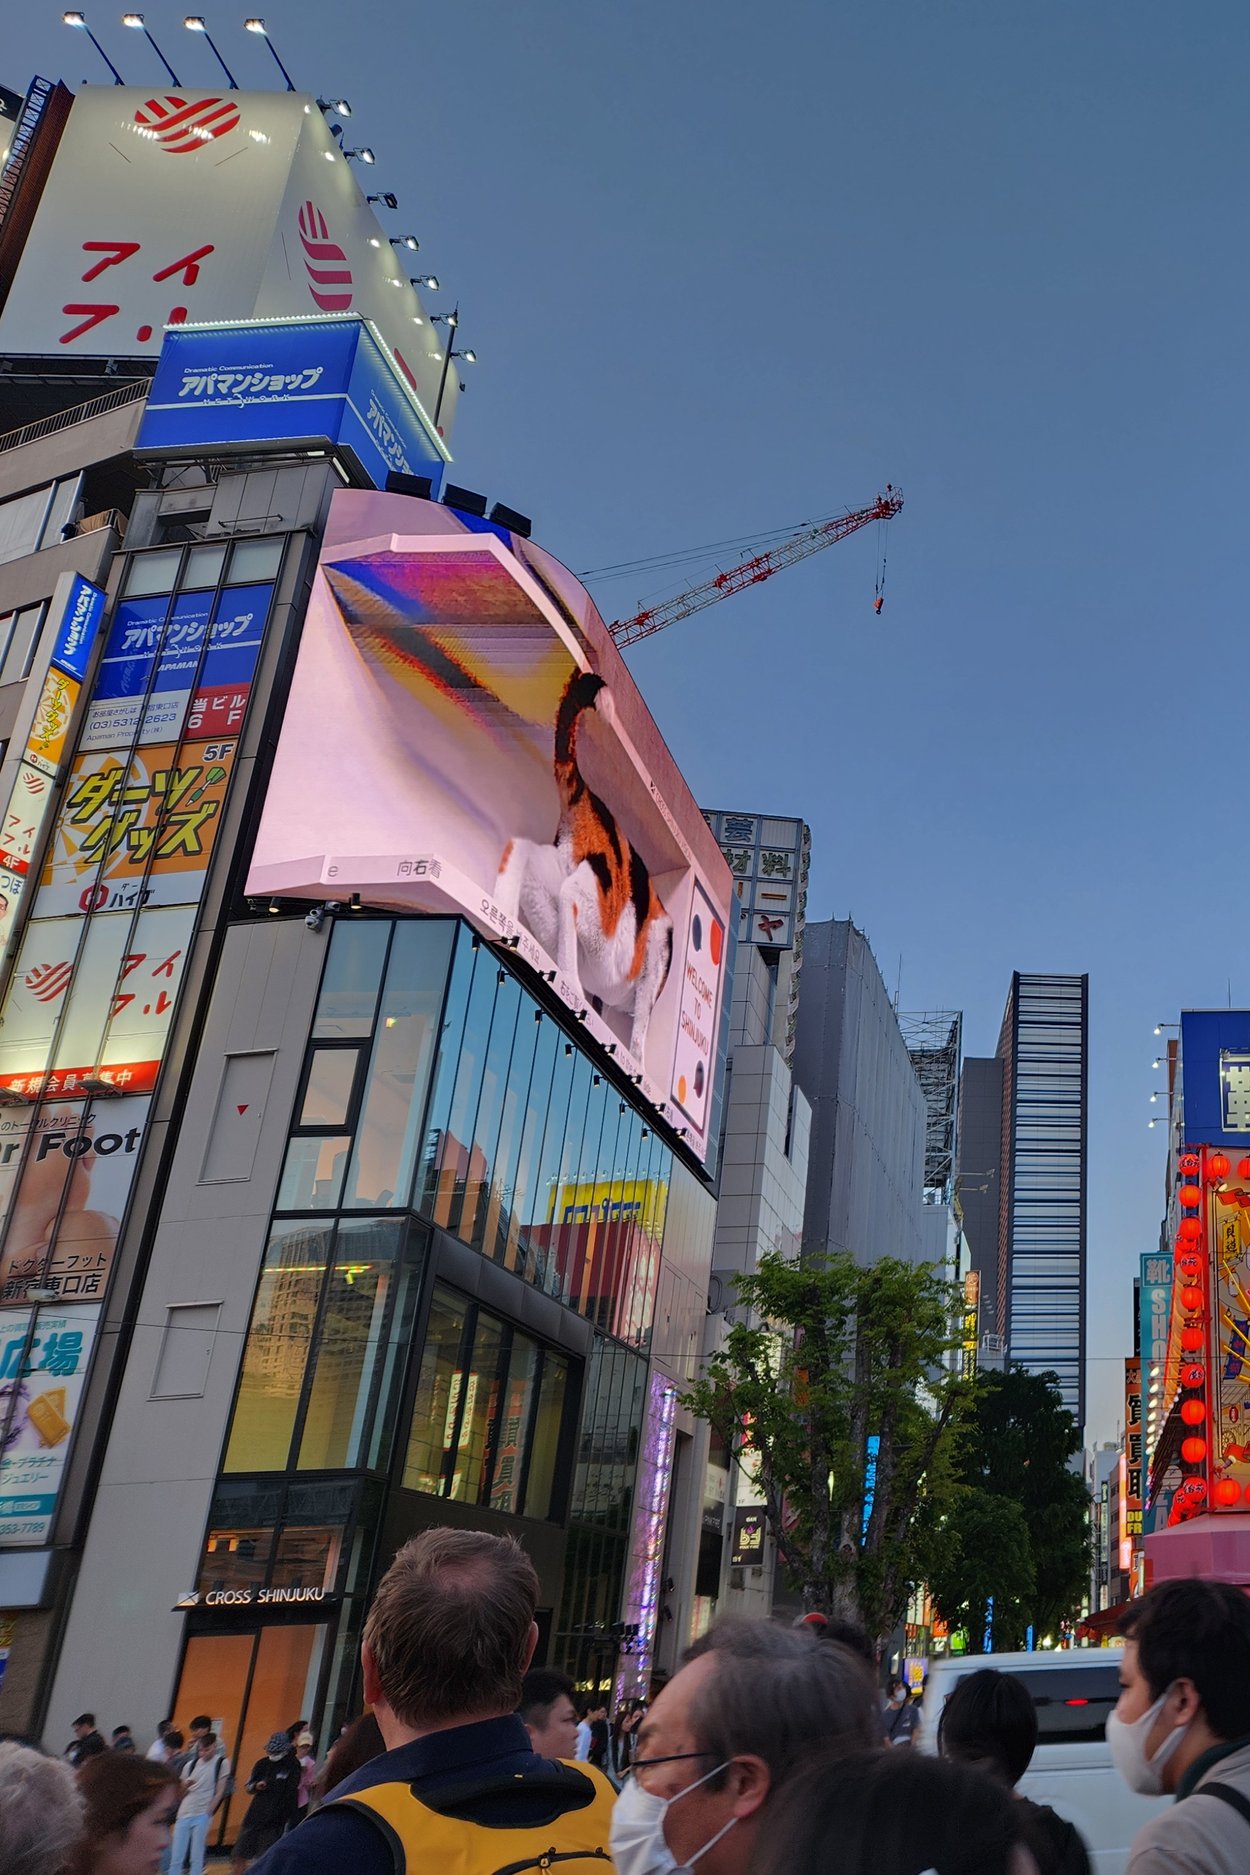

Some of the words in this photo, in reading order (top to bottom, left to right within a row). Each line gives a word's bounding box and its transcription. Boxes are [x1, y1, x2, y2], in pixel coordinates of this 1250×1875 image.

[82, 242, 214, 286] アイ
[178, 366, 324, 397] アパマンショップ
[203, 742, 235, 762] 5F
[66, 766, 204, 825] ダーツ
[79, 800, 221, 865] グッズ
[327, 865, 339, 877] e
[397, 858, 442, 879] 向右看
[686, 959, 713, 1008] WELCOME
[694, 997, 702, 1020] TO
[681, 1010, 710, 1057] SHINJUKU
[36, 1127, 142, 1162] Foot
[8, 1252, 107, 1275] ドクターフット
[205, 1589, 251, 1605] CROSS
[257, 1587, 326, 1604] SHINJUKU
